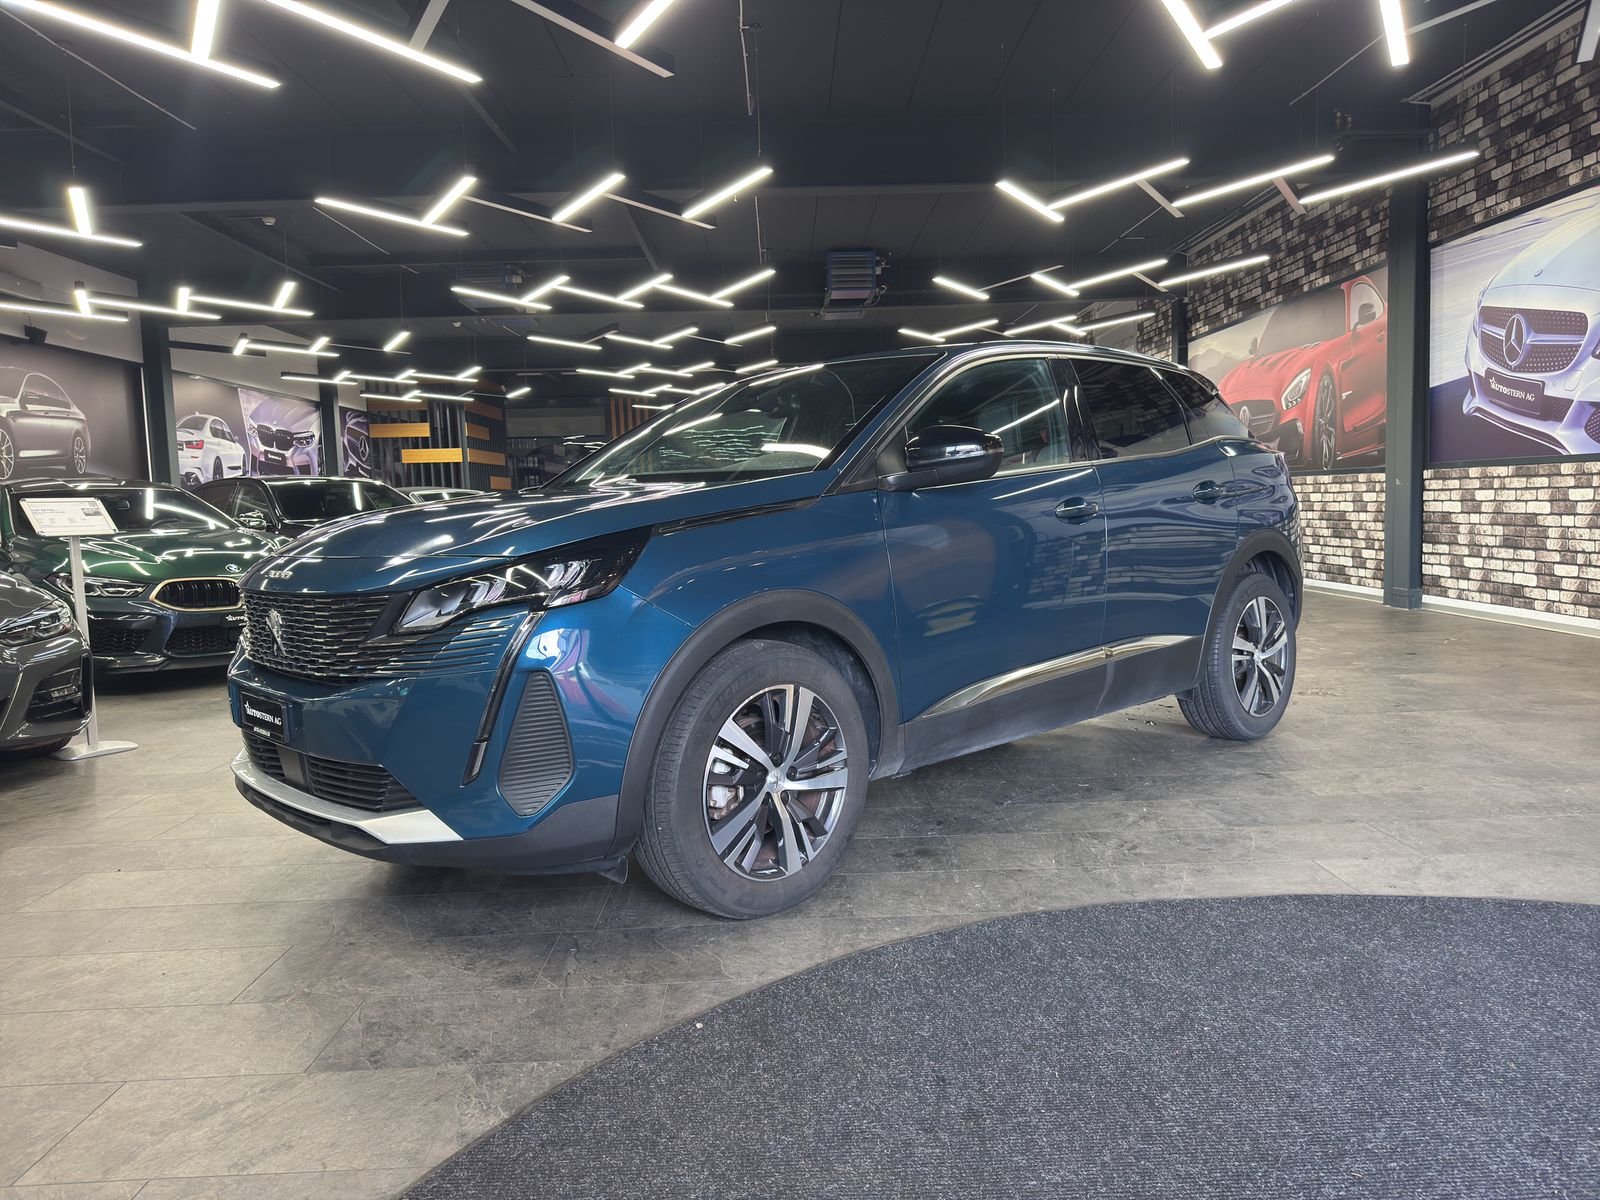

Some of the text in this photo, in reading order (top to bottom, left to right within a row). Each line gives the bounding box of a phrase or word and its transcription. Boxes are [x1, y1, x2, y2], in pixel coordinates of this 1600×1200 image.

[1490, 381, 1536, 402] AUTOSTERN AG
[246, 708, 282, 726] AUTOSTERN AG
